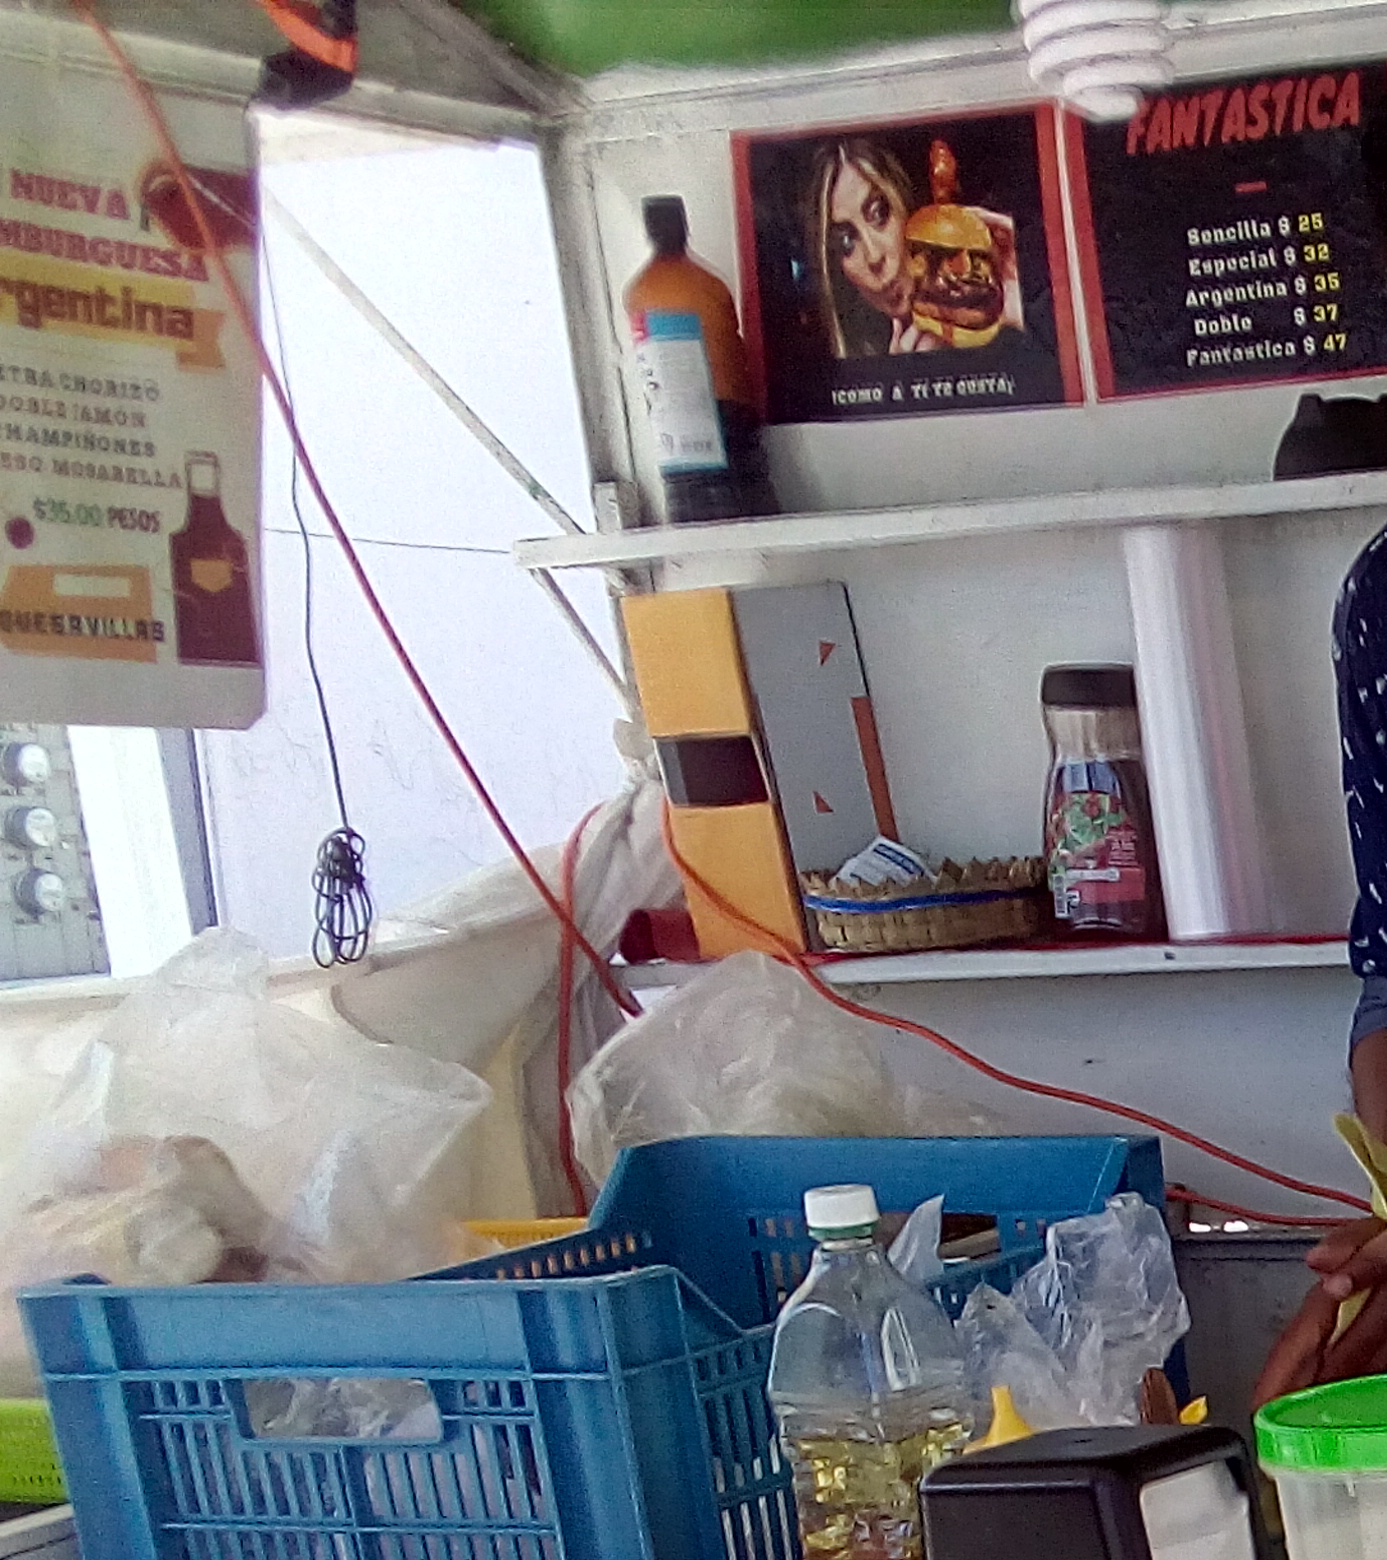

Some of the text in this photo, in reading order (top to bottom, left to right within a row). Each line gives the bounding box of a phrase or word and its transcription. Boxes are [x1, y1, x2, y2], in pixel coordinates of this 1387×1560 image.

[1126, 71, 1360, 155] FANTASTICA
[10, 167, 131, 221] NUEVA
[1186, 212, 1323, 246] Sencilla $ 25
[1188, 242, 1329, 278] Especial $ 32
[1185, 271, 1341, 308] Argentina $ 35
[1194, 303, 1338, 336] Doble $ 37
[1186, 333, 1347, 368] Fantastica $ 47
[59, 372, 160, 402] CHORIZO
[107, 504, 160, 534] PESOS
